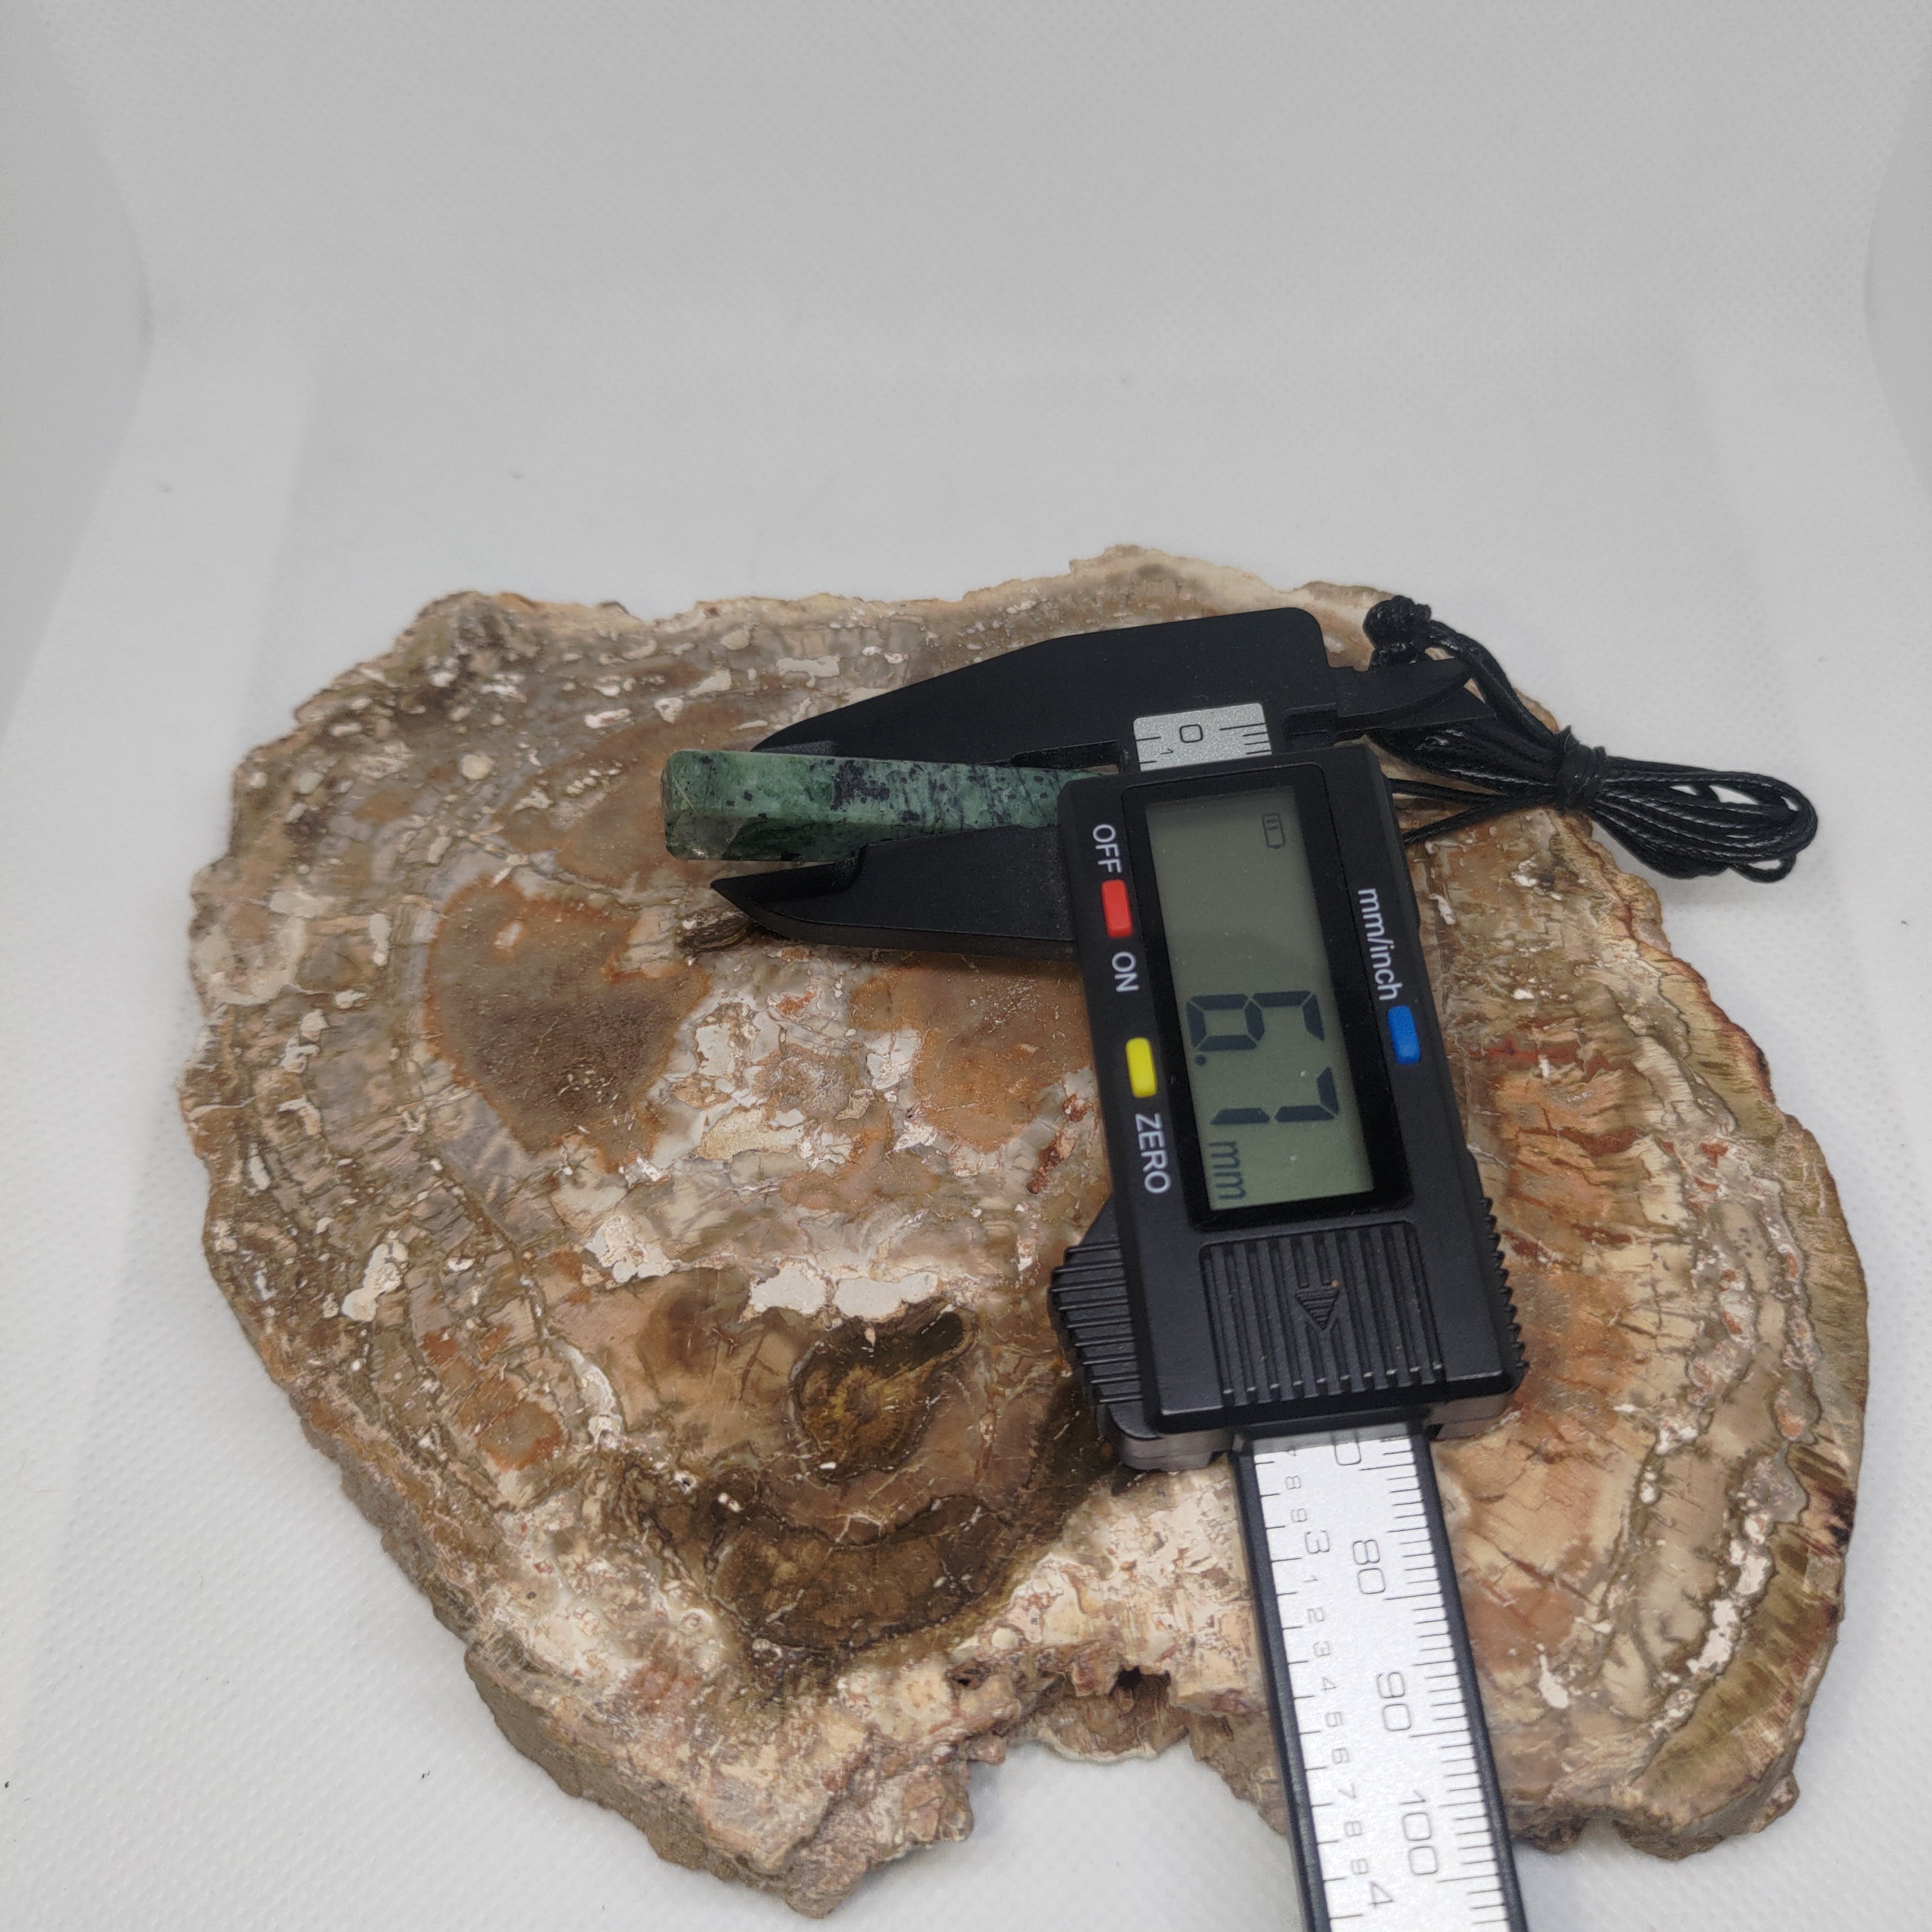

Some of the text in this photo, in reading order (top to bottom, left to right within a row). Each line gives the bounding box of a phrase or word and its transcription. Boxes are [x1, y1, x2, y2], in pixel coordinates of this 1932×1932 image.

[1179, 724, 1204, 743] 0
[1092, 824, 1122, 873] OFF
[1111, 951, 1139, 992] ON
[1358, 888, 1403, 1001] mm/inch
[1185, 990, 1339, 1200] 6.7 mm
[1135, 1112, 1171, 1194] ZERO
[1305, 1530, 1330, 1554] 3
[1368, 1881, 1394, 1908] 4
[1352, 1539, 1386, 1594] 80
[1377, 1671, 1412, 1731] 90
[1399, 1789, 1438, 1876] 100
